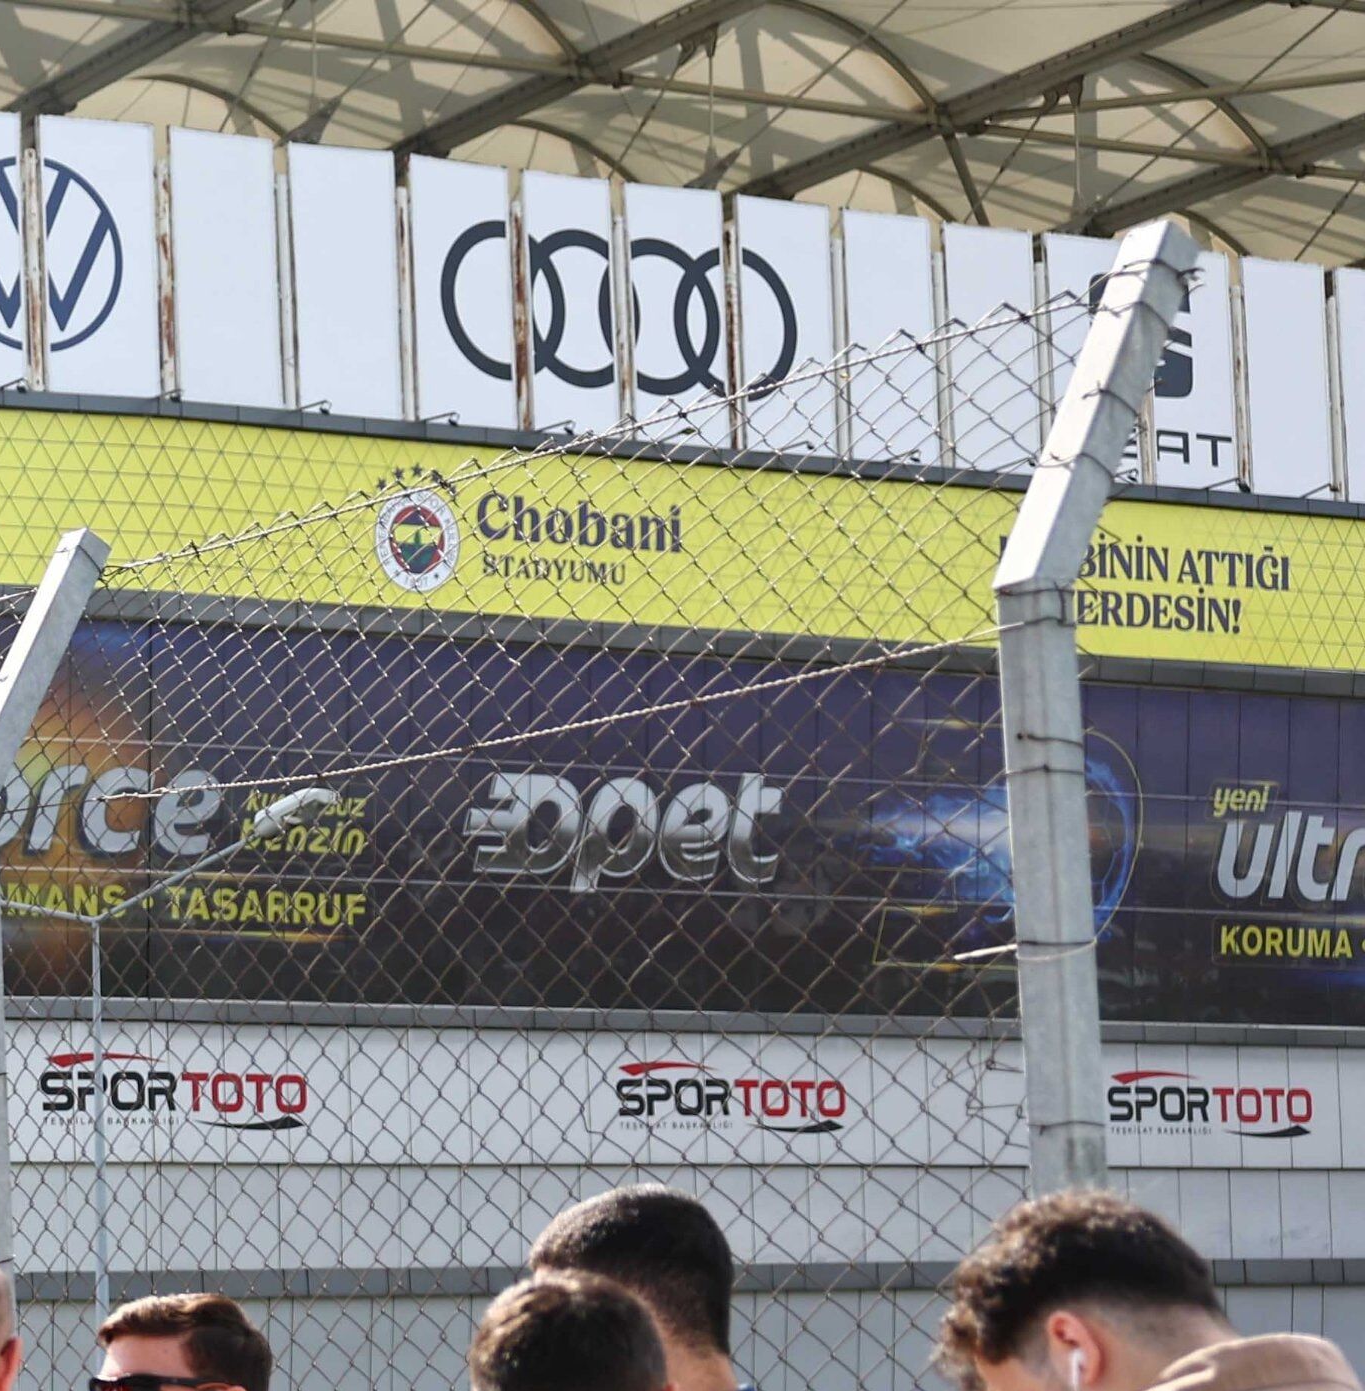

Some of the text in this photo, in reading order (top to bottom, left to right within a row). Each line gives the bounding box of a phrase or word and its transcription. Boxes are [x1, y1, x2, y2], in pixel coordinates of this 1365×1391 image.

[476, 491, 683, 553] Chobani
[482, 553, 626, 584] STADYUMU
[1176, 545, 1290, 592] ATTIĞI
[1213, 783, 1270, 818] yeni
[169, 887, 367, 927] TASARRUF
[1220, 923, 1354, 959] KORUMA
